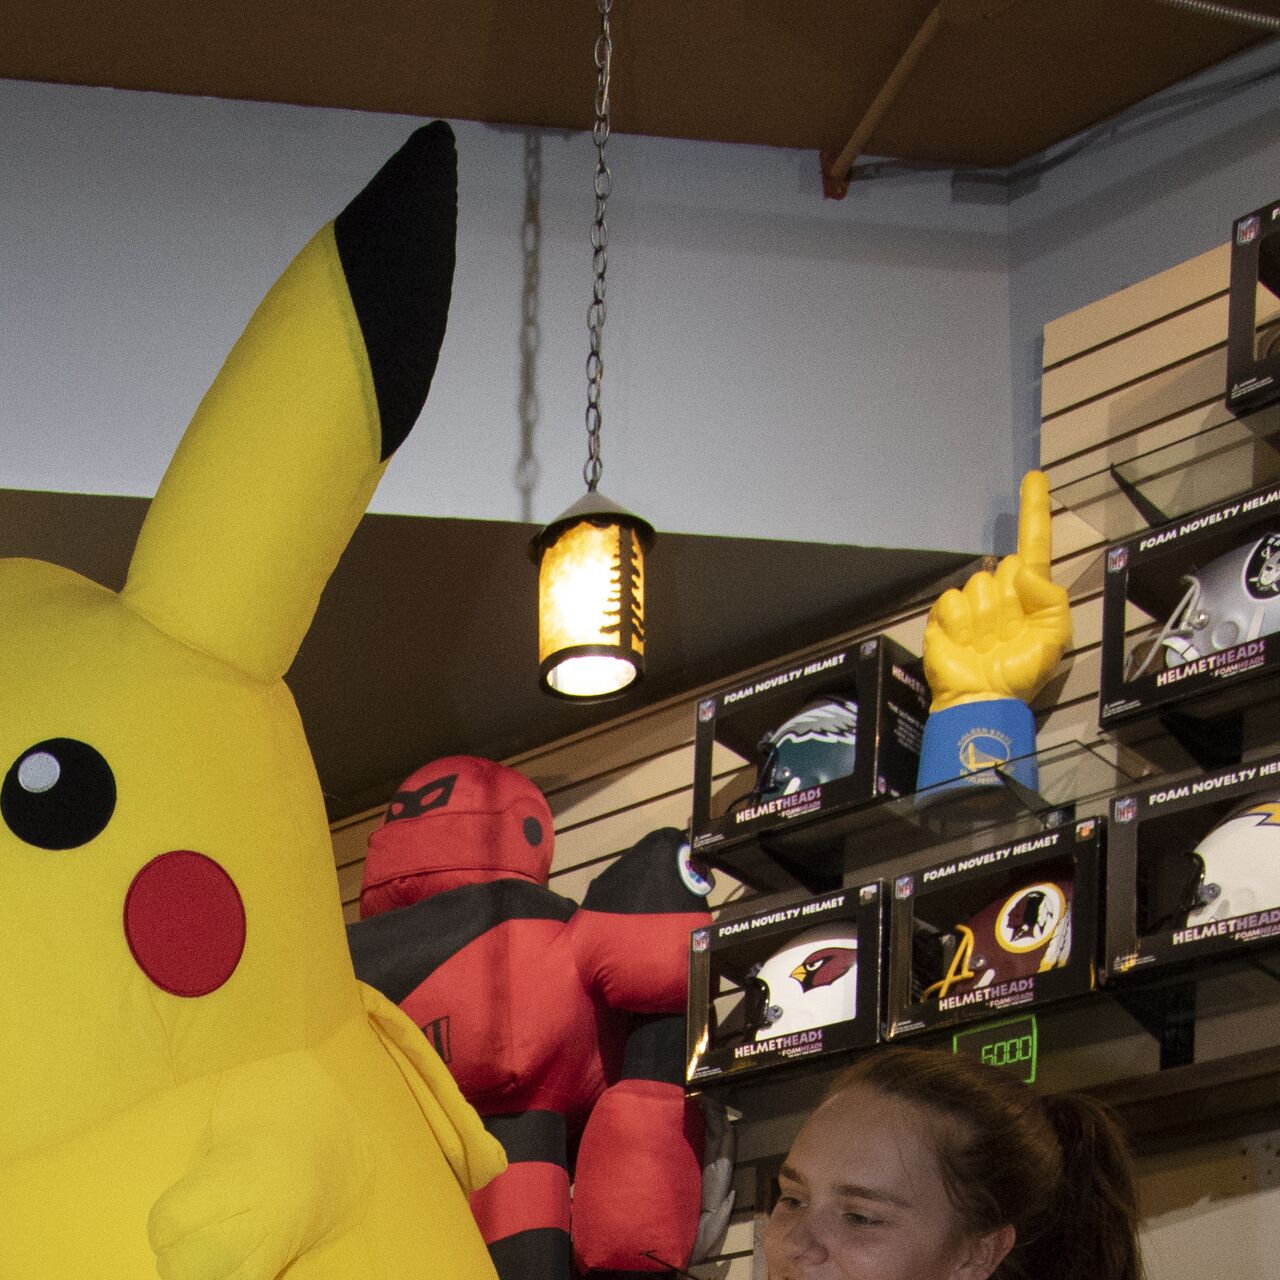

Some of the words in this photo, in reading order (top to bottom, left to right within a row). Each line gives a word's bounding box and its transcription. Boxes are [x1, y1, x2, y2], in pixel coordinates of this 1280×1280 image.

[1139, 529, 1177, 551] FOAM
[1179, 504, 1241, 536] NOVELTY
[1242, 489, 1280, 513] HELM
[723, 686, 754, 705] FOAM
[754, 669, 804, 693] NOVELTY
[803, 653, 847, 677] HELMET
[1156, 640, 1266, 687] HELMETHEADS
[735, 787, 822, 824] HELMETHEADS
[1148, 786, 1190, 806] FOAM
[1192, 768, 1258, 795] NOVELTY
[923, 864, 957, 883] FOAM
[957, 847, 1012, 872] NOVELTY
[1012, 833, 1060, 857] HELMET
[719, 921, 750, 938] FOAM
[750, 907, 801, 929] NOVELTY
[801, 895, 846, 916] HELMET
[938, 976, 1035, 1012] HELMETHEADS
[734, 1029, 824, 1059] HELMETHEADS
